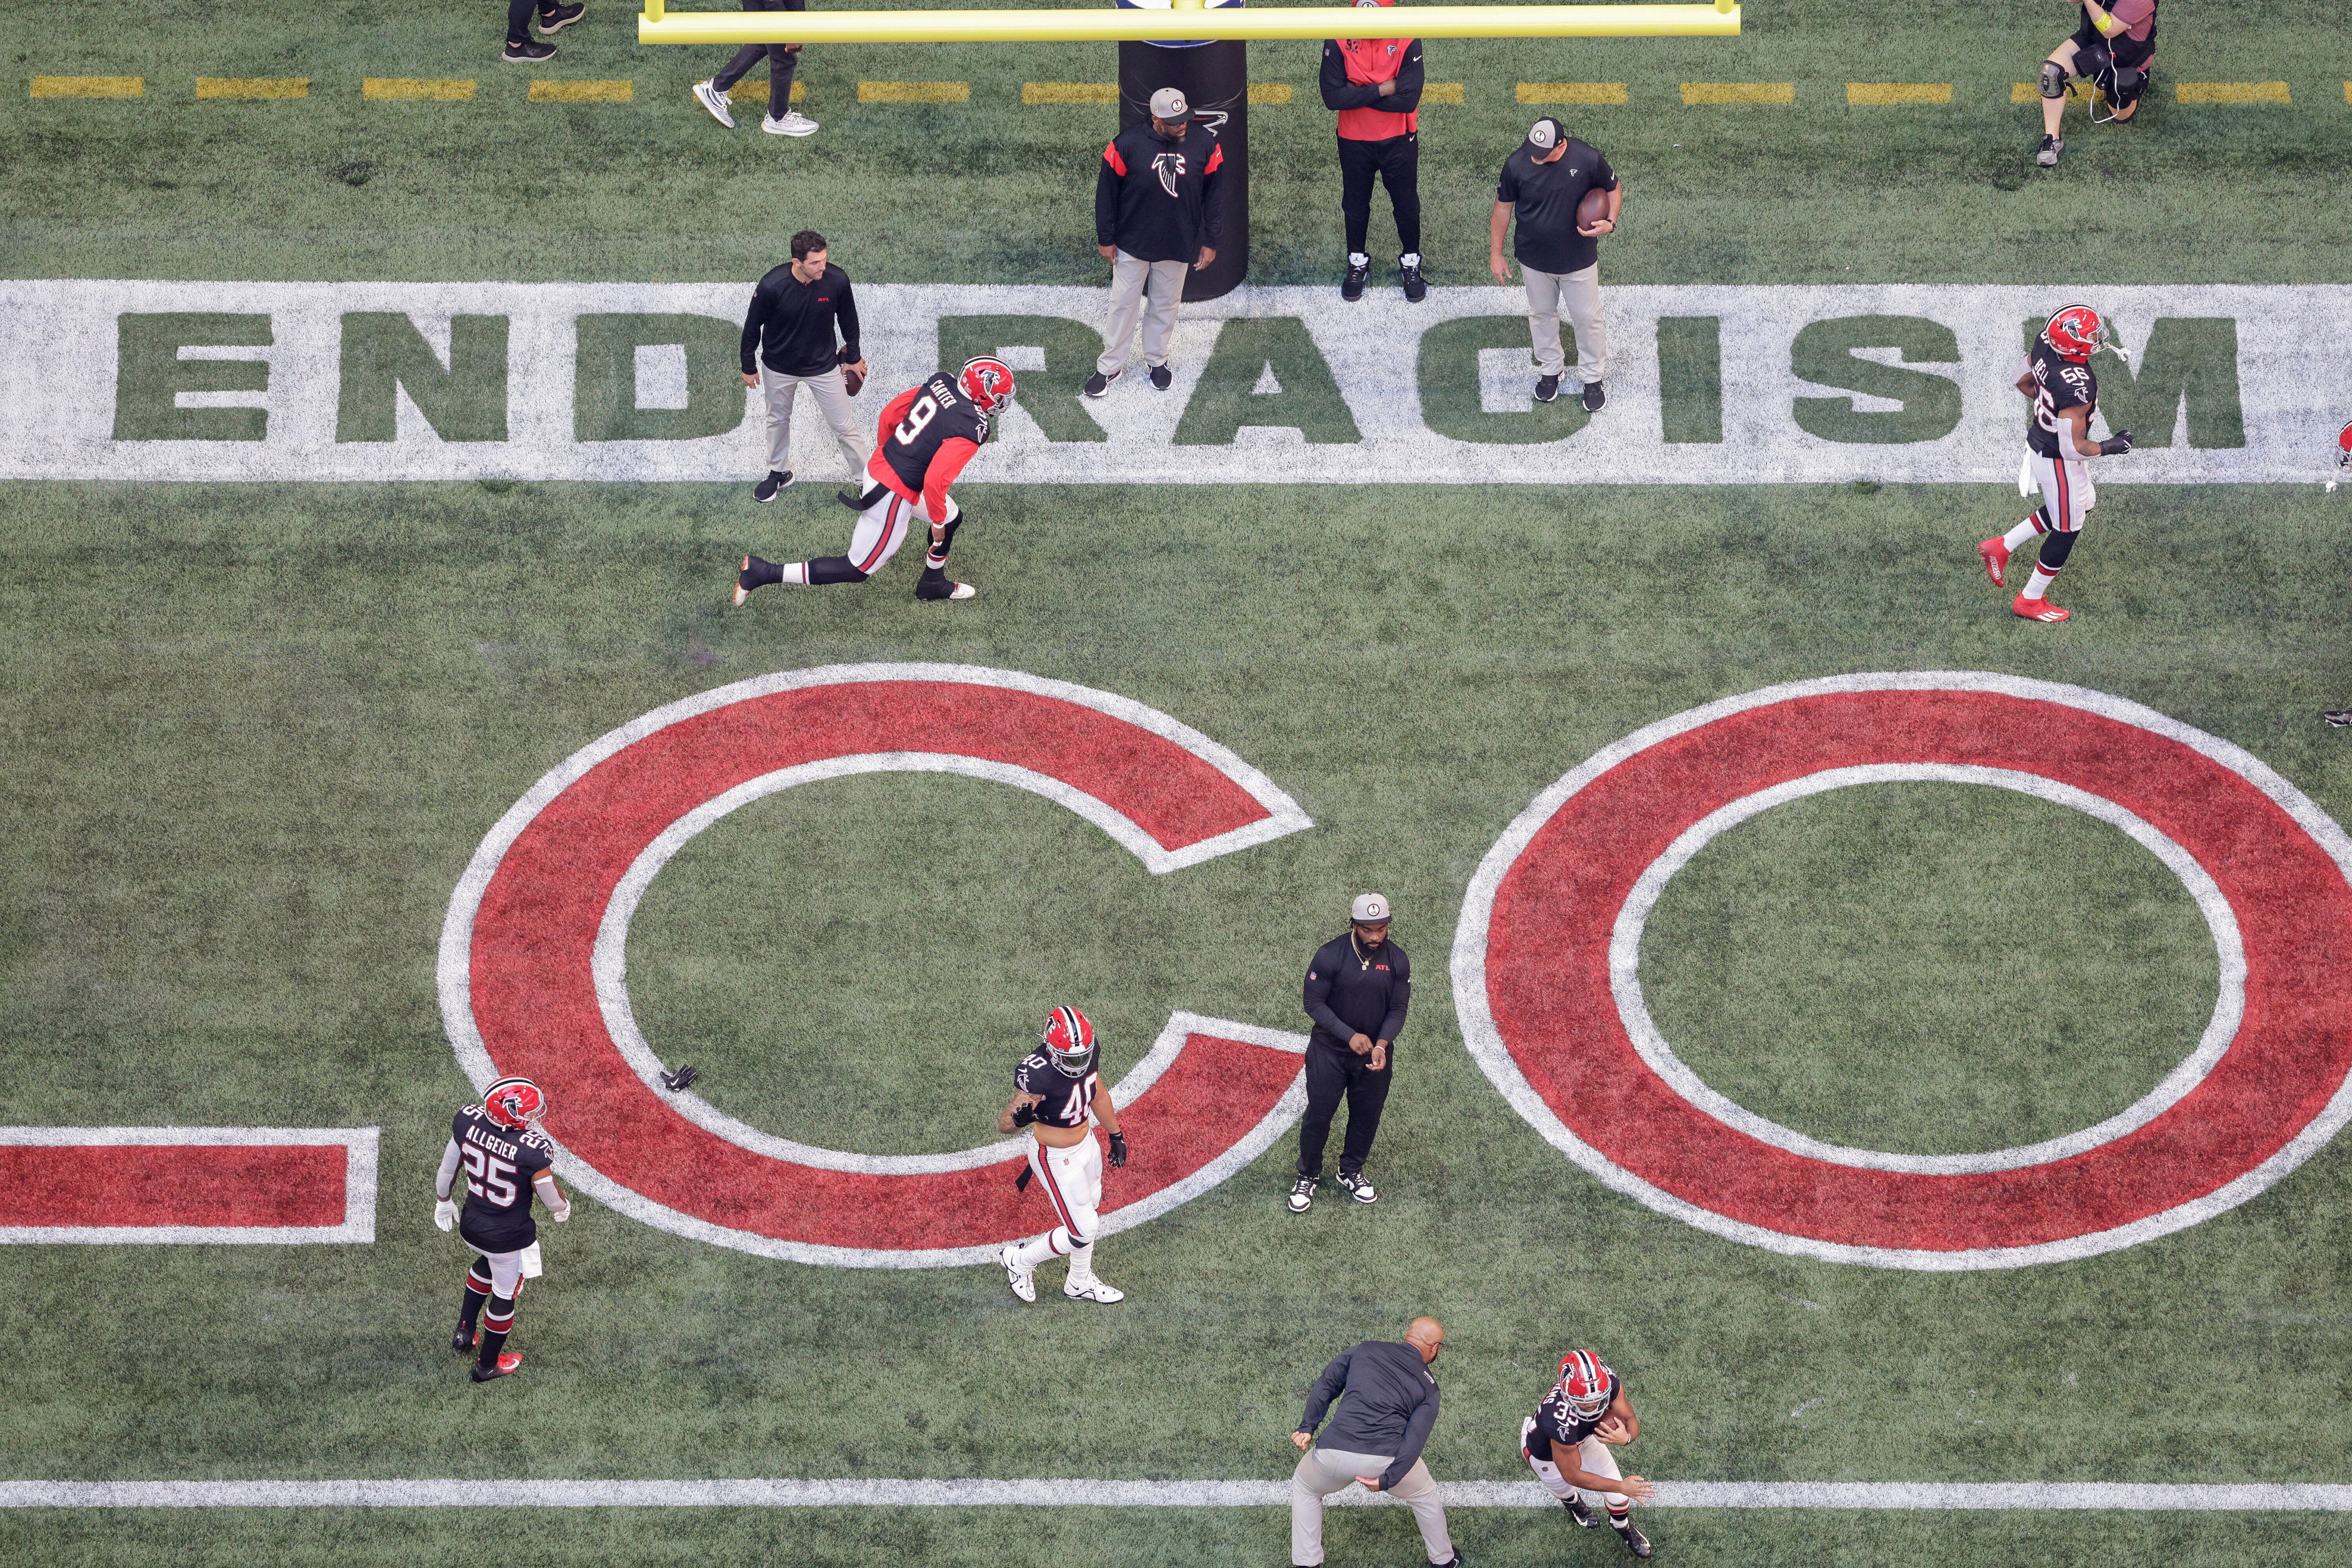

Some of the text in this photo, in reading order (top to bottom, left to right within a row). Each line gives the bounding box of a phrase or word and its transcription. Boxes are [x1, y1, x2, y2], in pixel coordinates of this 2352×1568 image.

[1345, 39, 1359, 53] 92
[112, 312, 2245, 448] END RACISM
[2034, 358, 2049, 385] BELL
[2060, 367, 2090, 384] 56
[929, 379, 957, 409] CARTER
[894, 394, 938, 446] 9
[1989, 555, 2002, 580] ADIZERO
[1021, 1054, 1047, 1069] 40
[465, 1124, 518, 1161] ALLGEIER
[461, 1141, 518, 1208] 25
[1553, 1401, 1579, 1426] 35
